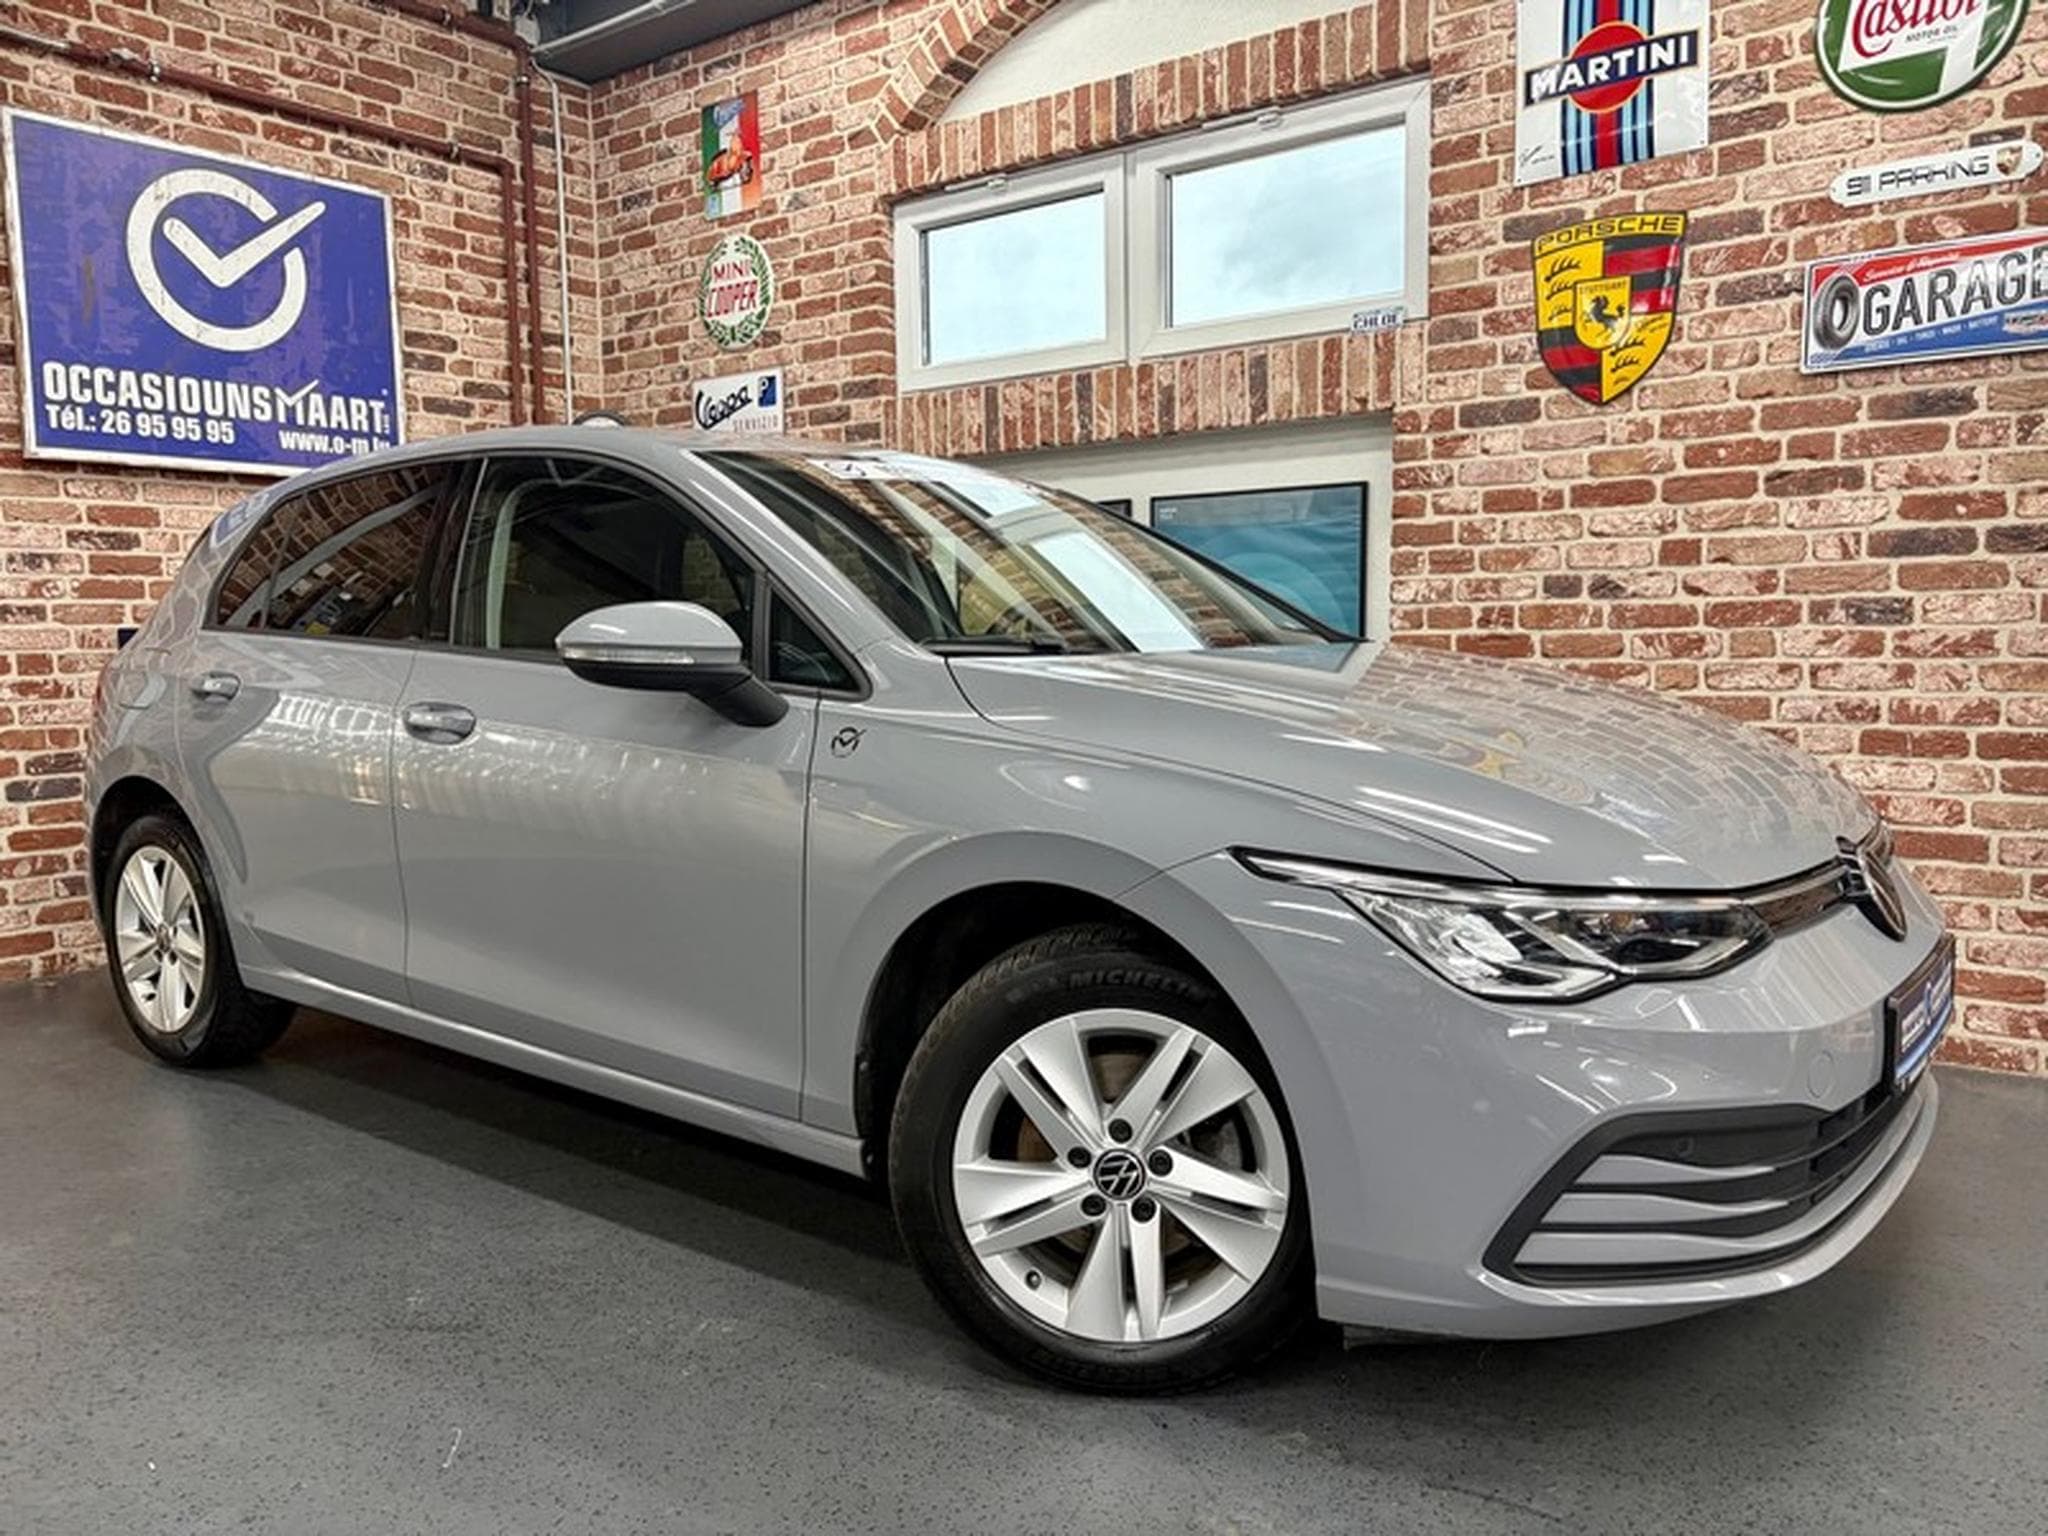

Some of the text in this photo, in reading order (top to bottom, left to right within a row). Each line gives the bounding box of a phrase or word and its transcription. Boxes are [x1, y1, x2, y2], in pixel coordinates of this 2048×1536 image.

[1852, 0, 1982, 58] Castro
[1530, 35, 1690, 102] MARTINI
[1878, 154, 1991, 192] PARKING
[1537, 215, 1681, 254] PORSCHE
[712, 259, 752, 281] MINI
[1862, 244, 2048, 336] GARAGE
[707, 279, 758, 318] COOPER
[45, 403, 235, 445] Tél.: 26 95 95 95
[695, 386, 752, 430] Vespa
